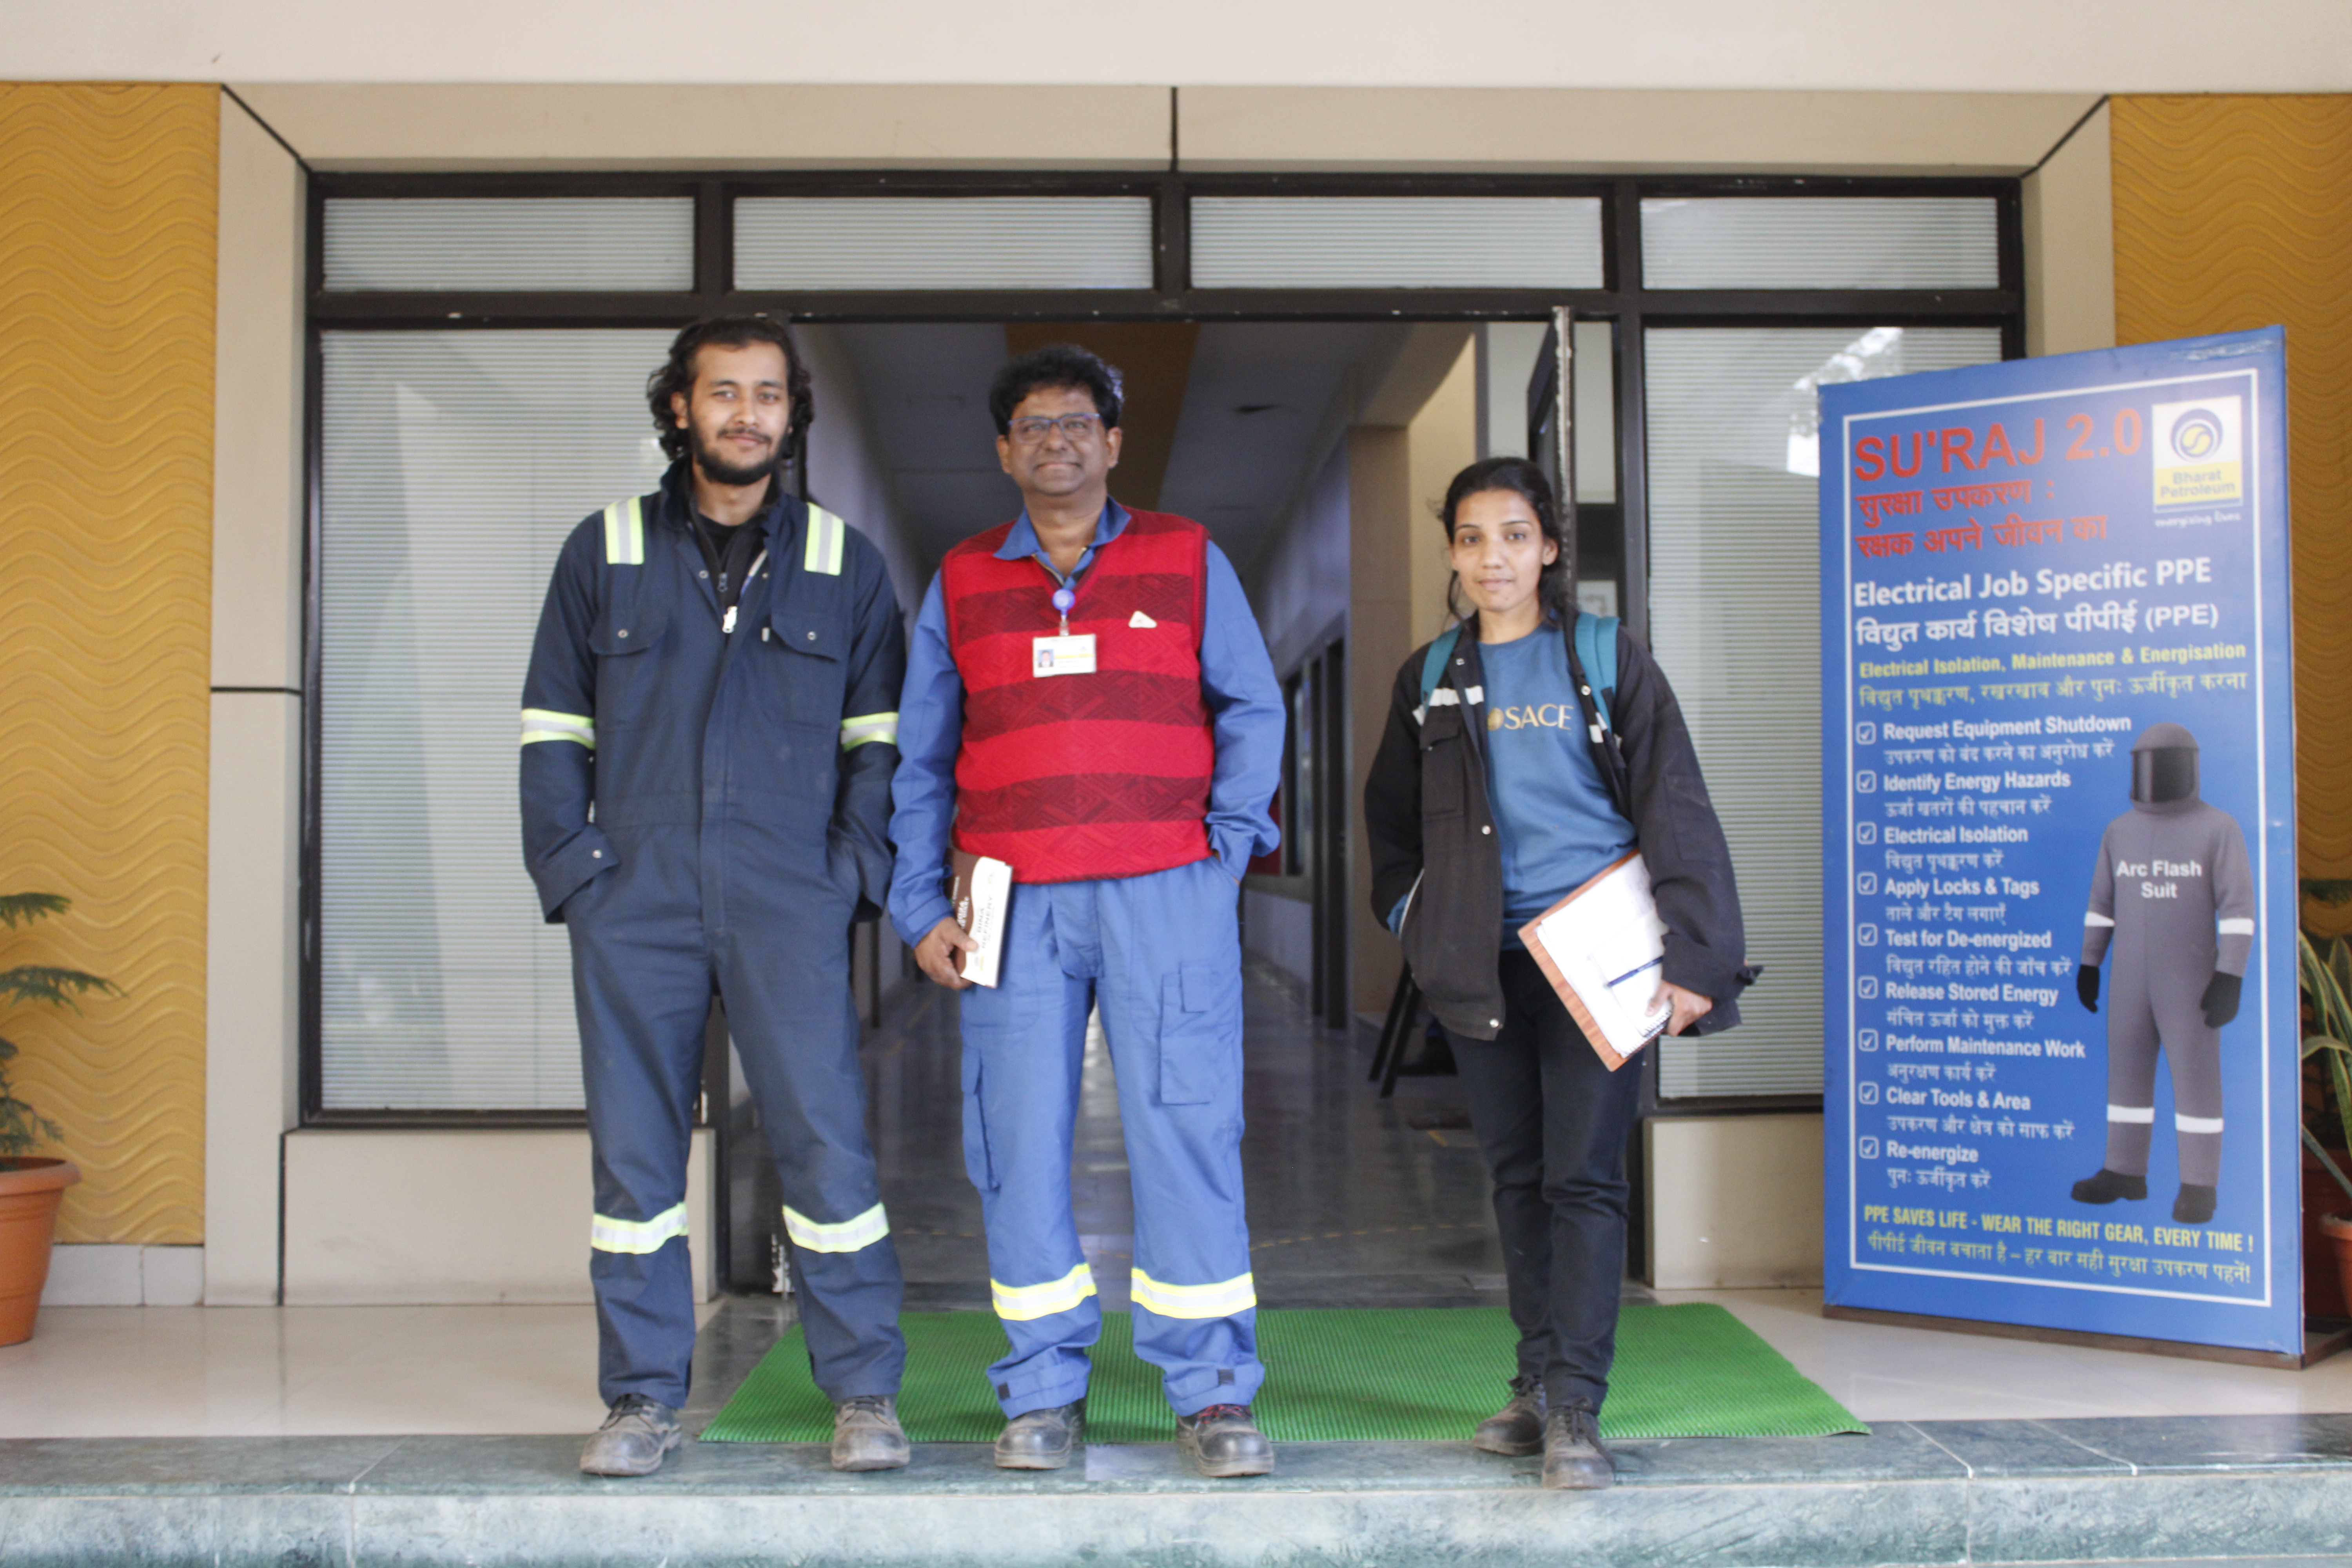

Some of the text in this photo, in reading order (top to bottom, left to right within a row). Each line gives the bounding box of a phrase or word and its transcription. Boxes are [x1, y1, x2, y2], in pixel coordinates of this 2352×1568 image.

[1855, 408, 2142, 481] SU'RAJ 2.0
[2173, 470, 2221, 484] Bharat
[1856, 490, 1923, 528] सुरक्षा
[1931, 480, 2032, 510] उपकरण
[2161, 483, 2235, 499] Petroleum
[1855, 513, 2108, 558] रक्षक अपने जीवन का
[1855, 557, 2212, 607] Electrical Job Specific PPE
[1856, 599, 2219, 652] विद्युत कार्य विशेष पीपीई (PPE)
[1860, 642, 2246, 678] Electrical Isolation, Maintenance & Energisation
[1860, 685, 1904, 711] विद्युत
[1980, 682, 2050, 700] रखरखाव
[2056, 675, 2085, 697] और
[2200, 672, 2248, 690] करना
[1884, 715, 2131, 742] Request Equipment Shutdown
[1884, 737, 2115, 765] उपकरण को बंद करने का अनुरोध करें
[1884, 769, 2071, 794] Identify Energy Hazards
[1884, 793, 2053, 819] ऊर्जा खतरों की पहचान करें
[1884, 825, 2028, 844] Electrical Isolation
[1885, 849, 1923, 874] विद्युत
[1982, 848, 2004, 869] करें
[2116, 860, 2202, 877] Arc Flash
[1885, 877, 2040, 899] Apply Locks & Tags
[2141, 881, 2178, 898] Suit
[981, 896, 995, 949] REFINERY
[1916, 902, 1942, 922] और
[1943, 902, 1964, 922] टैग
[1885, 929, 2052, 951] Test for De-energized
[1886, 953, 1924, 979] विद्युत
[1927, 955, 1962, 980] रहित
[1964, 955, 1991, 978] होने
[1994, 955, 2013, 976] की
[2050, 956, 2073, 977] करें
[1886, 983, 2058, 1006] Release Stored Energy
[1927, 1008, 1958, 1028] ऊर्जा
[1961, 1008, 1980, 1027] को
[2012, 1009, 2035, 1030] करें
[1886, 1035, 2085, 1058] Perform Maintenance Work
[1943, 1061, 1972, 1082] कार्य
[1975, 1062, 1997, 1082] करें
[1887, 1086, 2031, 1110] Clear Tools & Area
[1887, 1116, 1938, 1133] उपकरण
[1942, 1114, 1966, 1134] और
[1996, 1116, 2016, 1136] को
[2052, 1118, 2076, 1140] करें
[1887, 1139, 1978, 1165] Re-energize
[1970, 1169, 1993, 1188] करें
[1864, 1205, 1889, 1223] PPE
[1893, 1207, 1935, 1227] SAVES
[1939, 1211, 1968, 1229] LIFE
[1981, 1213, 2021, 1233] WEAR
[2026, 1217, 2052, 1236] THE
[2057, 1220, 2100, 1240] RIGHT
[2105, 1223, 2149, 1245] GEAR,
[2154, 1227, 2201, 1248] EVERY
[2207, 1231, 2242, 1251] TIME
[1867, 1231, 1906, 1252] पीपीई
[1909, 1234, 1947, 1256] जीवन
[1949, 1241, 1993, 1260] बचाता
[1996, 1240, 2007, 1266] है
[2024, 1247, 2044, 1267] हर
[2046, 1249, 2074, 1266] बार
[2076, 1248, 2105, 1274] सही
[2108, 1254, 2149, 1277] सुरक्षा
[2151, 1259, 2209, 1279] उपकरण
